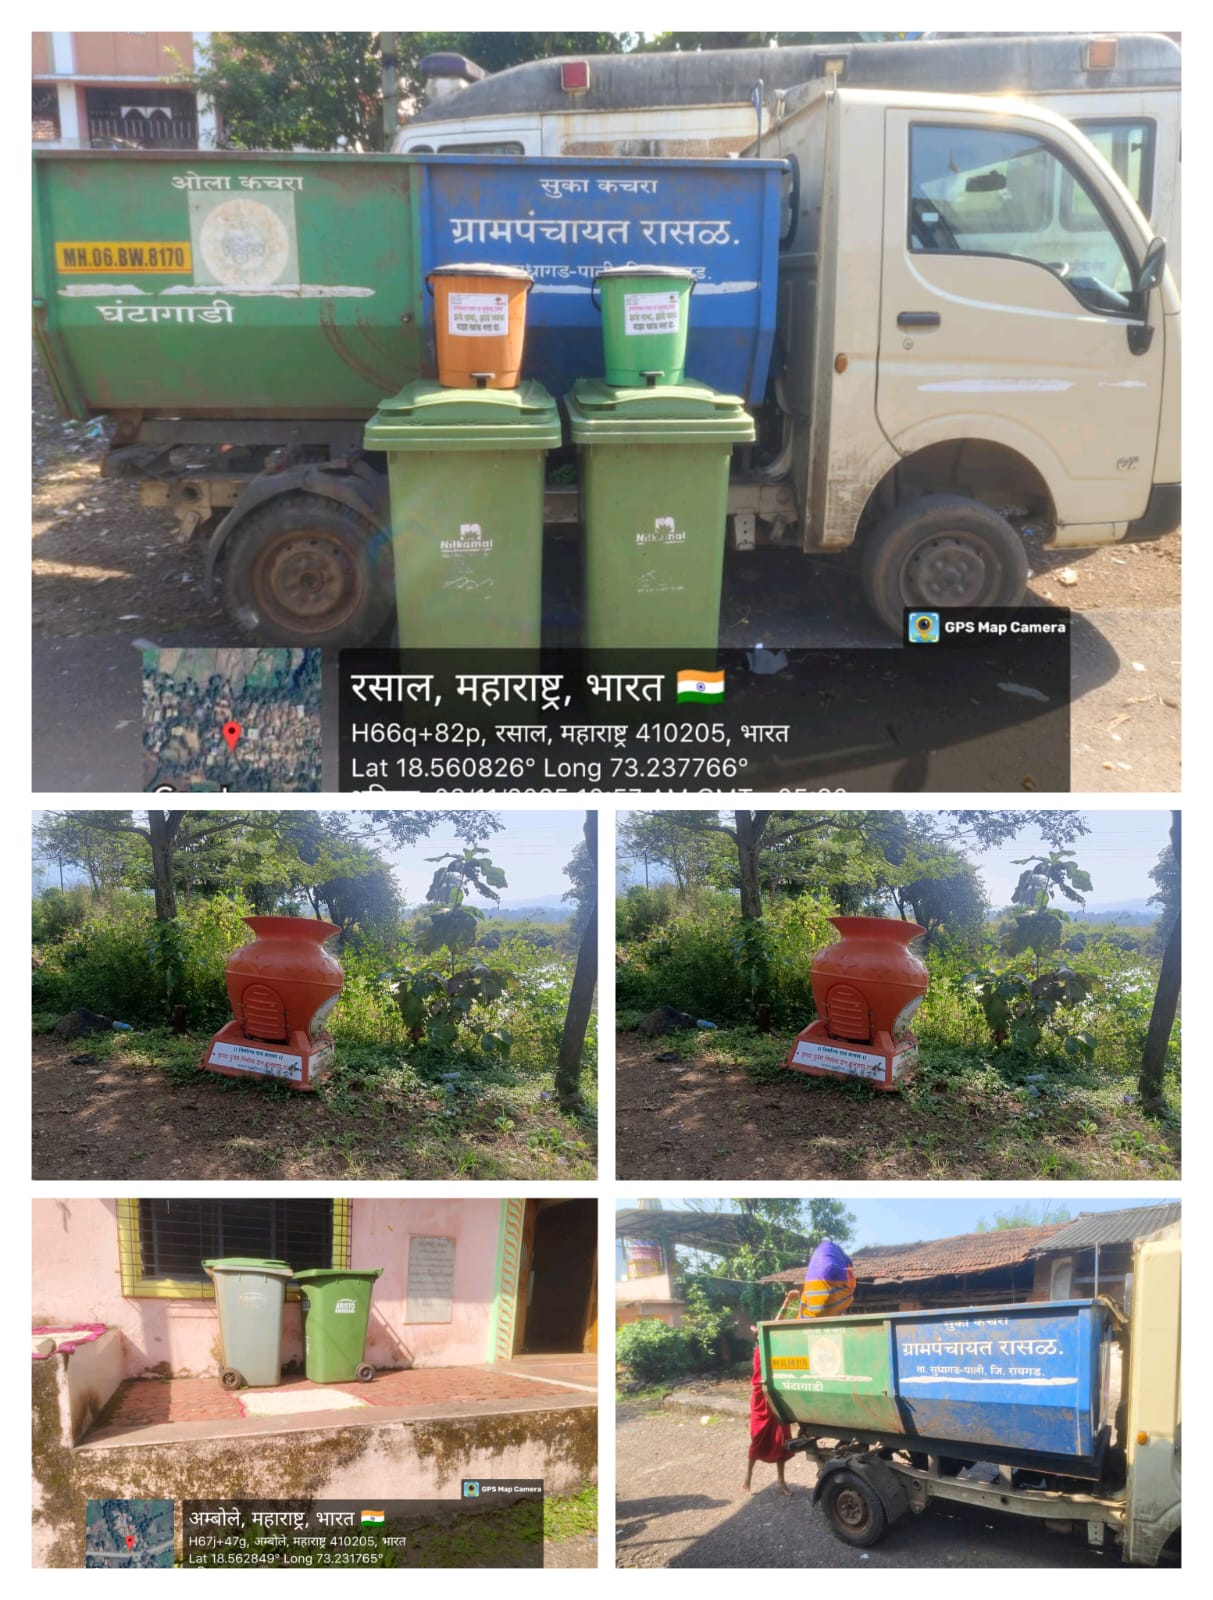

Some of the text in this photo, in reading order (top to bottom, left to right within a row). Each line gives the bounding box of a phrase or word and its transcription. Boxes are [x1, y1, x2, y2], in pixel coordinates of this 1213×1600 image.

[171, 171, 304, 191] ओला कचरा
[540, 179, 658, 198] सुका कचरा
[450, 210, 740, 245] ग्रामपंचायत रासळ.
[63, 247, 185, 267] MH.06.BW.8170
[96, 299, 235, 323] घंटागाडी
[441, 538, 493, 549] Nilkamal
[902, 1337, 1065, 1356] ग्रामपंचायत रासळ.
